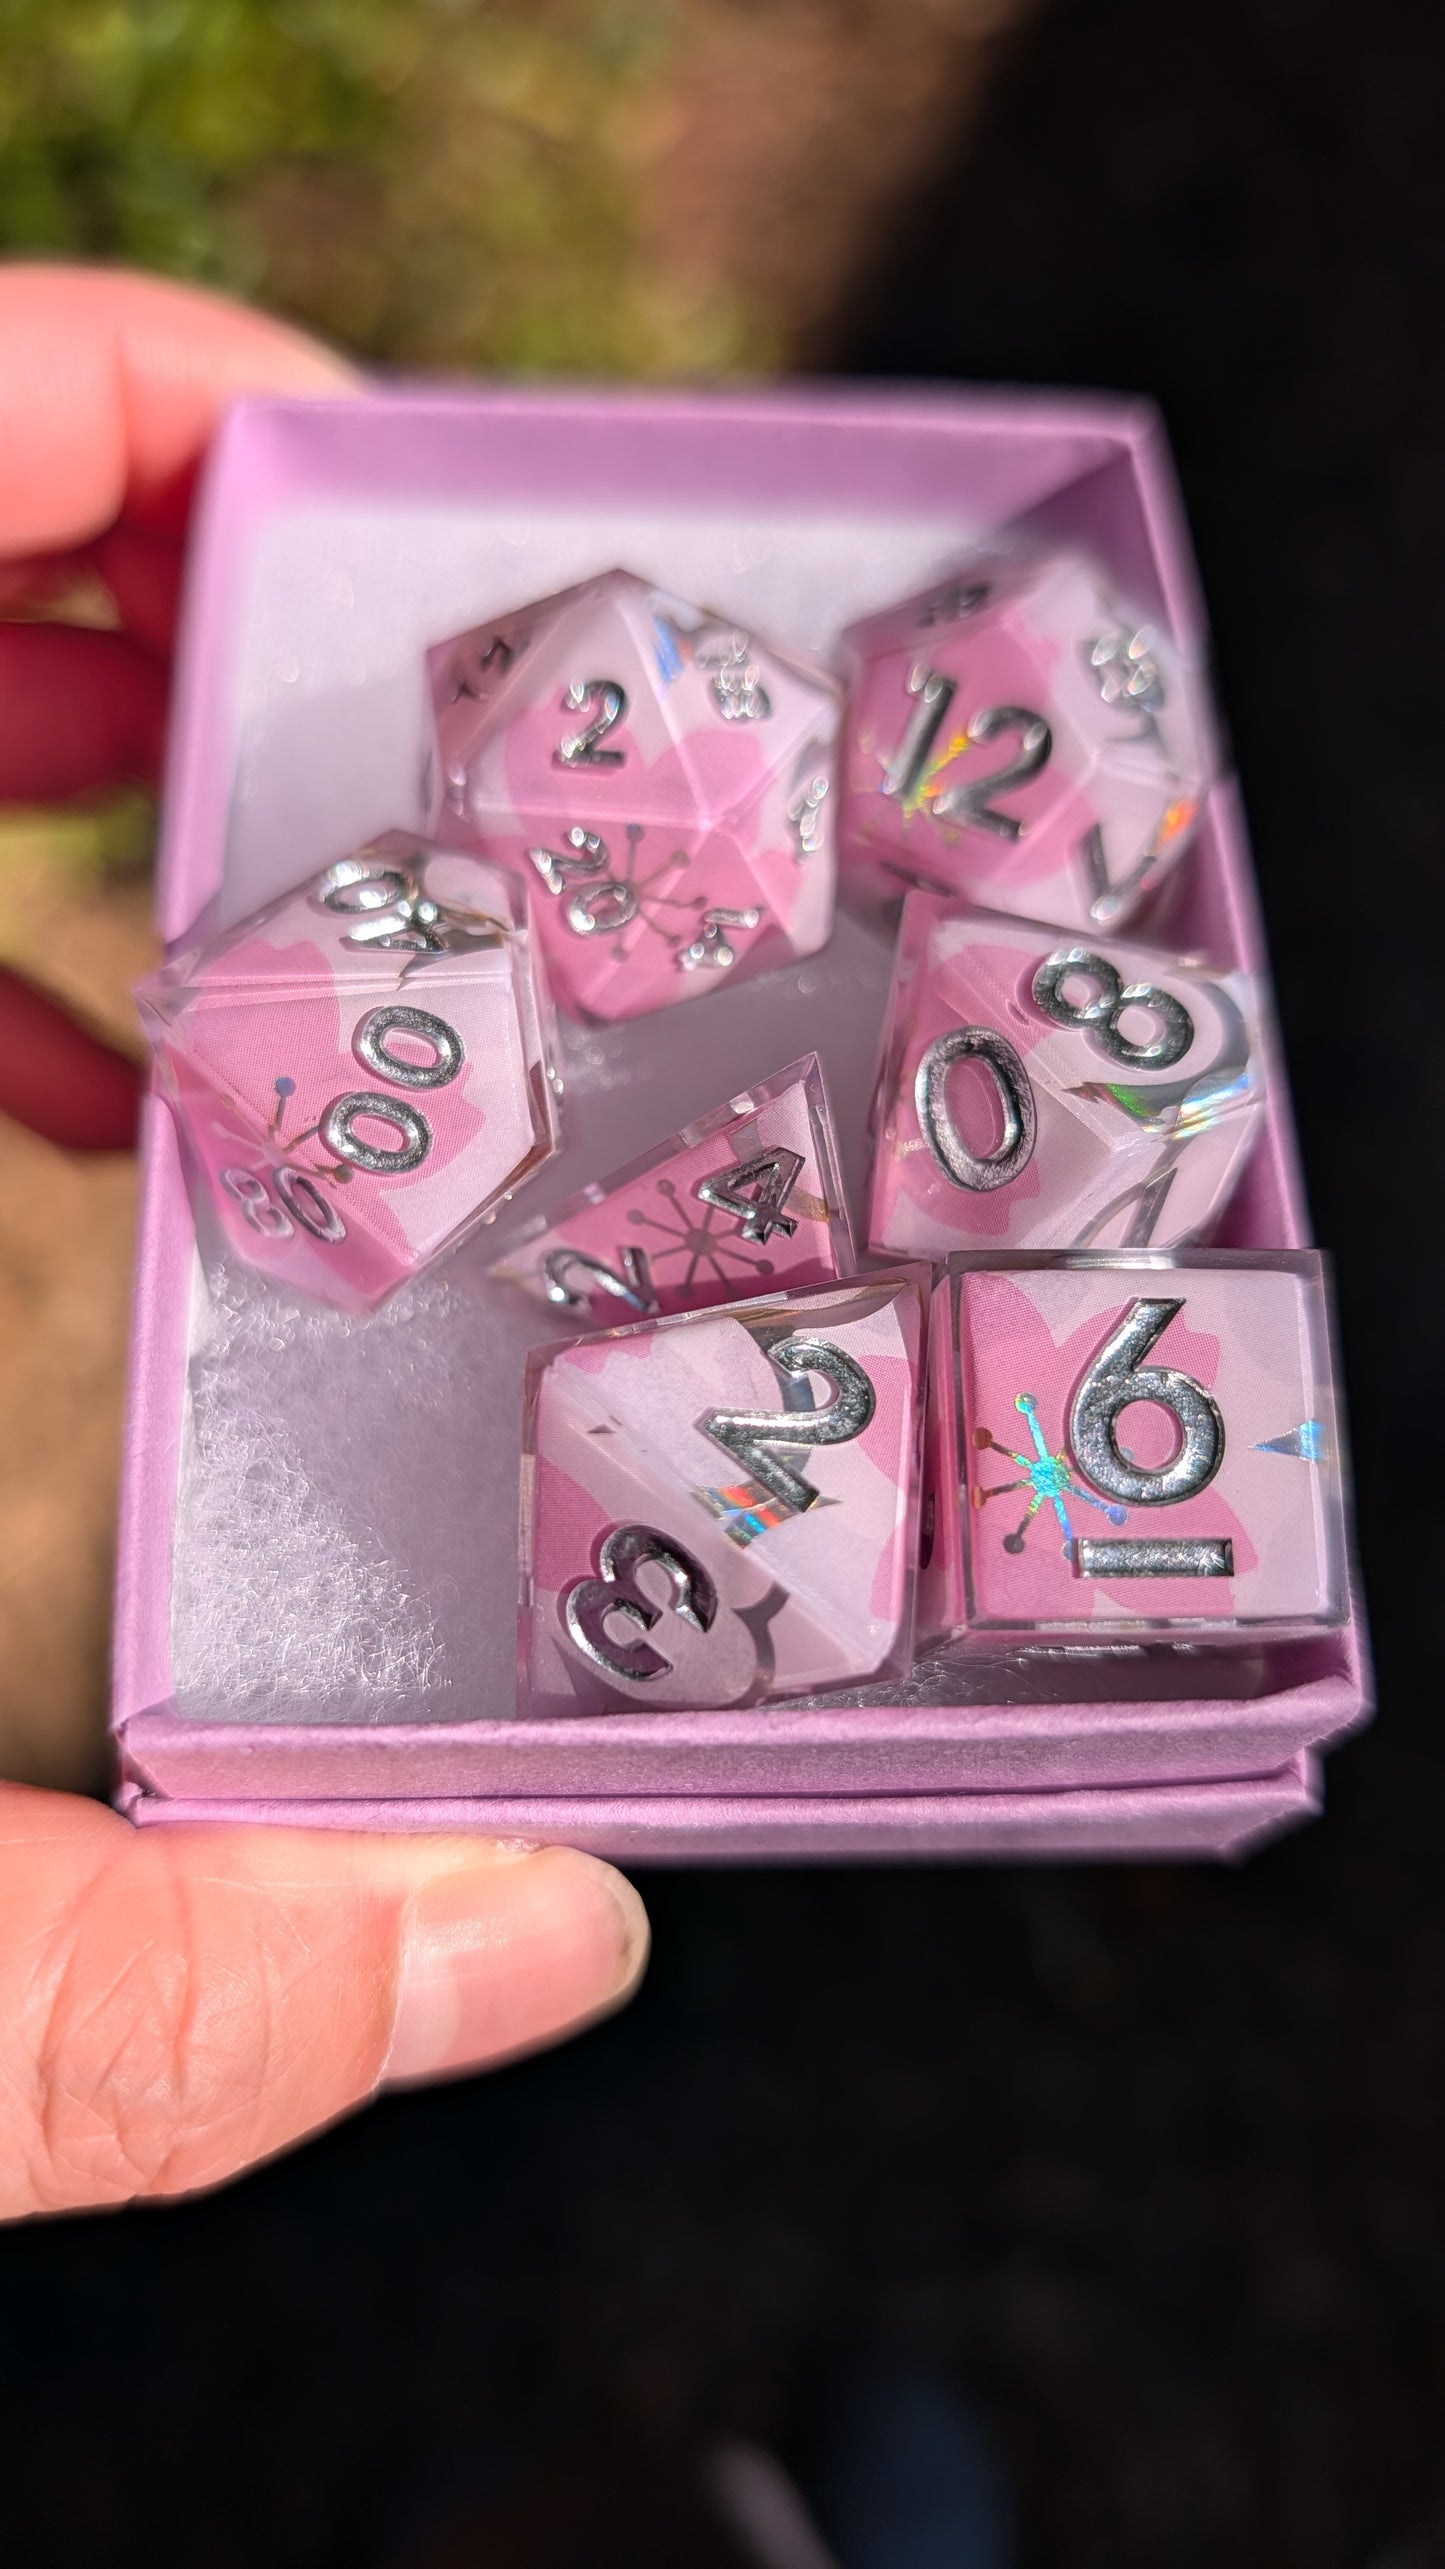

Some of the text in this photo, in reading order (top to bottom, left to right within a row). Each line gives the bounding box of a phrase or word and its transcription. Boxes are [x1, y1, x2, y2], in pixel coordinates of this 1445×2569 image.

[551, 680, 629, 768] 2
[880, 664, 1053, 844] 12
[527, 826, 639, 936] 20
[1032, 931, 1195, 1072] 8
[322, 1004, 466, 1175] 00
[914, 1025, 1037, 1193] 0
[220, 1165, 347, 1245] 80
[697, 1146, 806, 1246] 4
[540, 1248, 661, 1316] 2
[694, 1335, 877, 1512] 2
[1071, 1297, 1226, 1507] 6
[557, 1523, 720, 1682] 3
